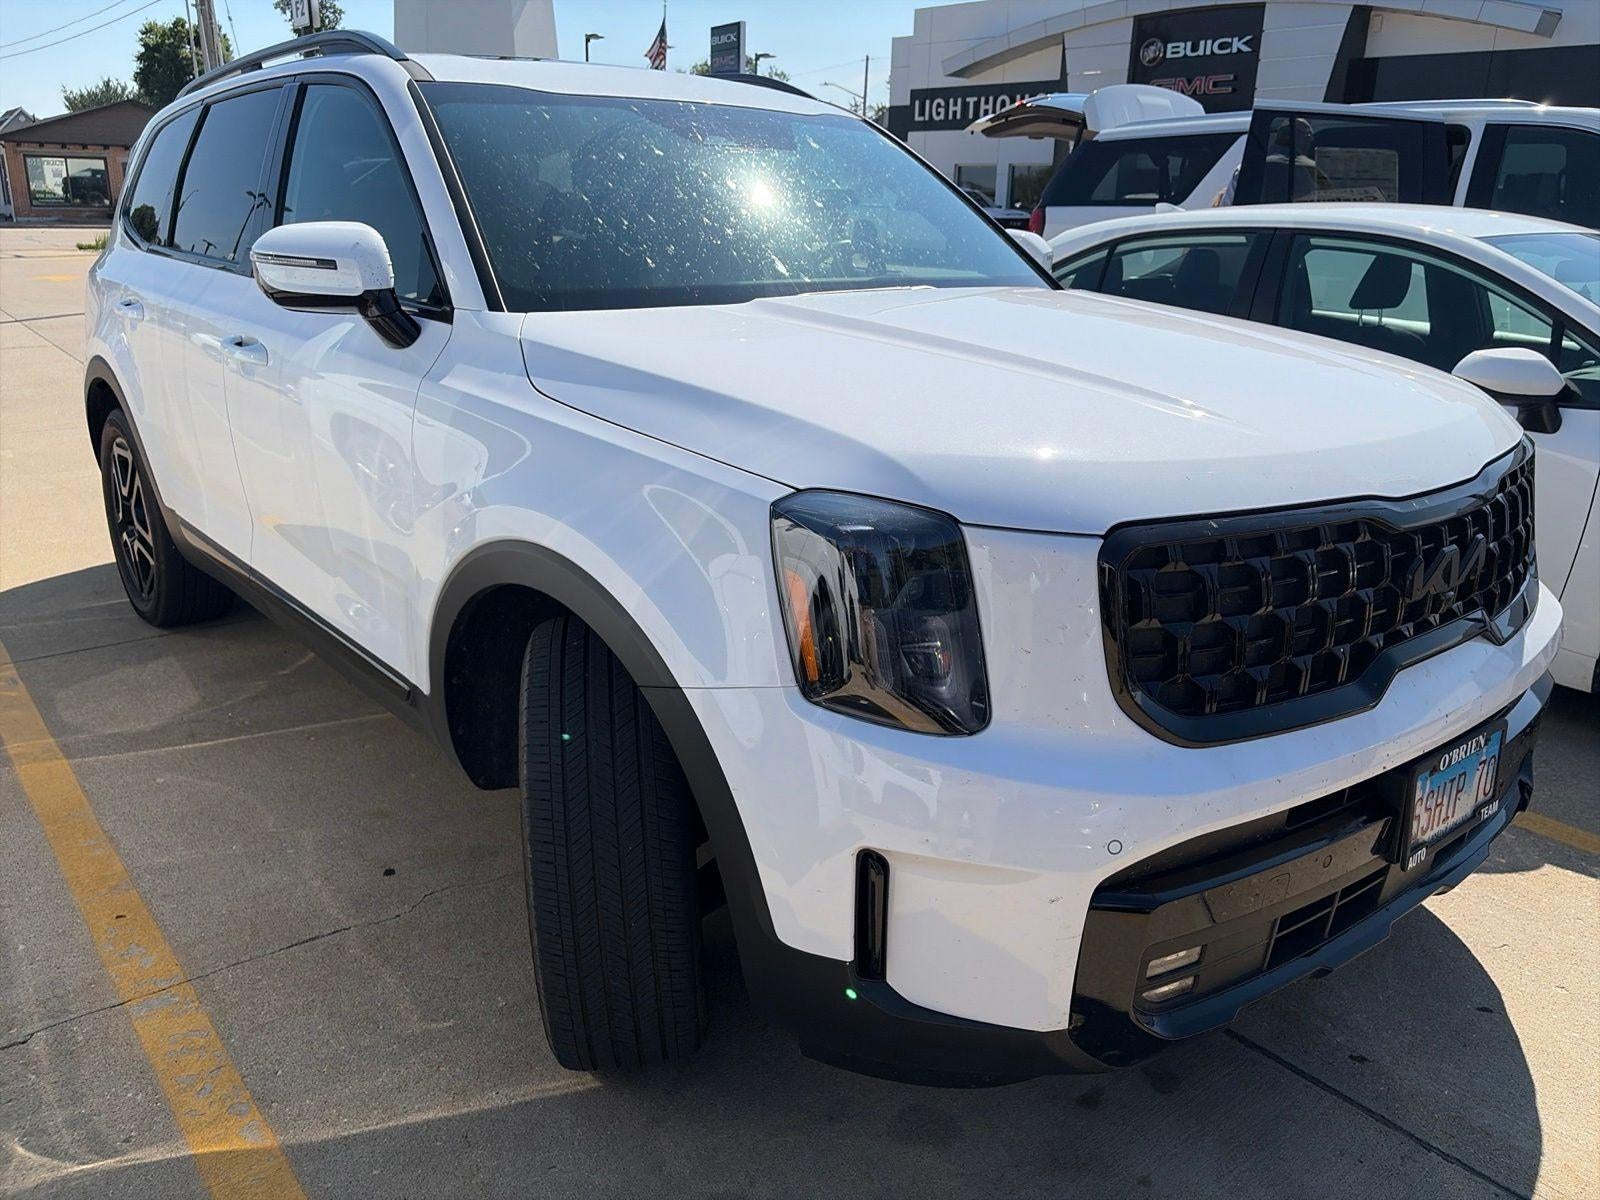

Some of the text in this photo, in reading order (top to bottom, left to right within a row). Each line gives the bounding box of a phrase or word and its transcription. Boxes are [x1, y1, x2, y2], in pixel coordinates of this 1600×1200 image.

[711, 31, 737, 46] BUICK
[1166, 35, 1254, 59] BUICK
[1439, 731, 1488, 771] O'BRIEN
[1475, 754, 1496, 803] 70
[1480, 800, 1499, 821] TEAM
[1407, 847, 1426, 870] AUTO
